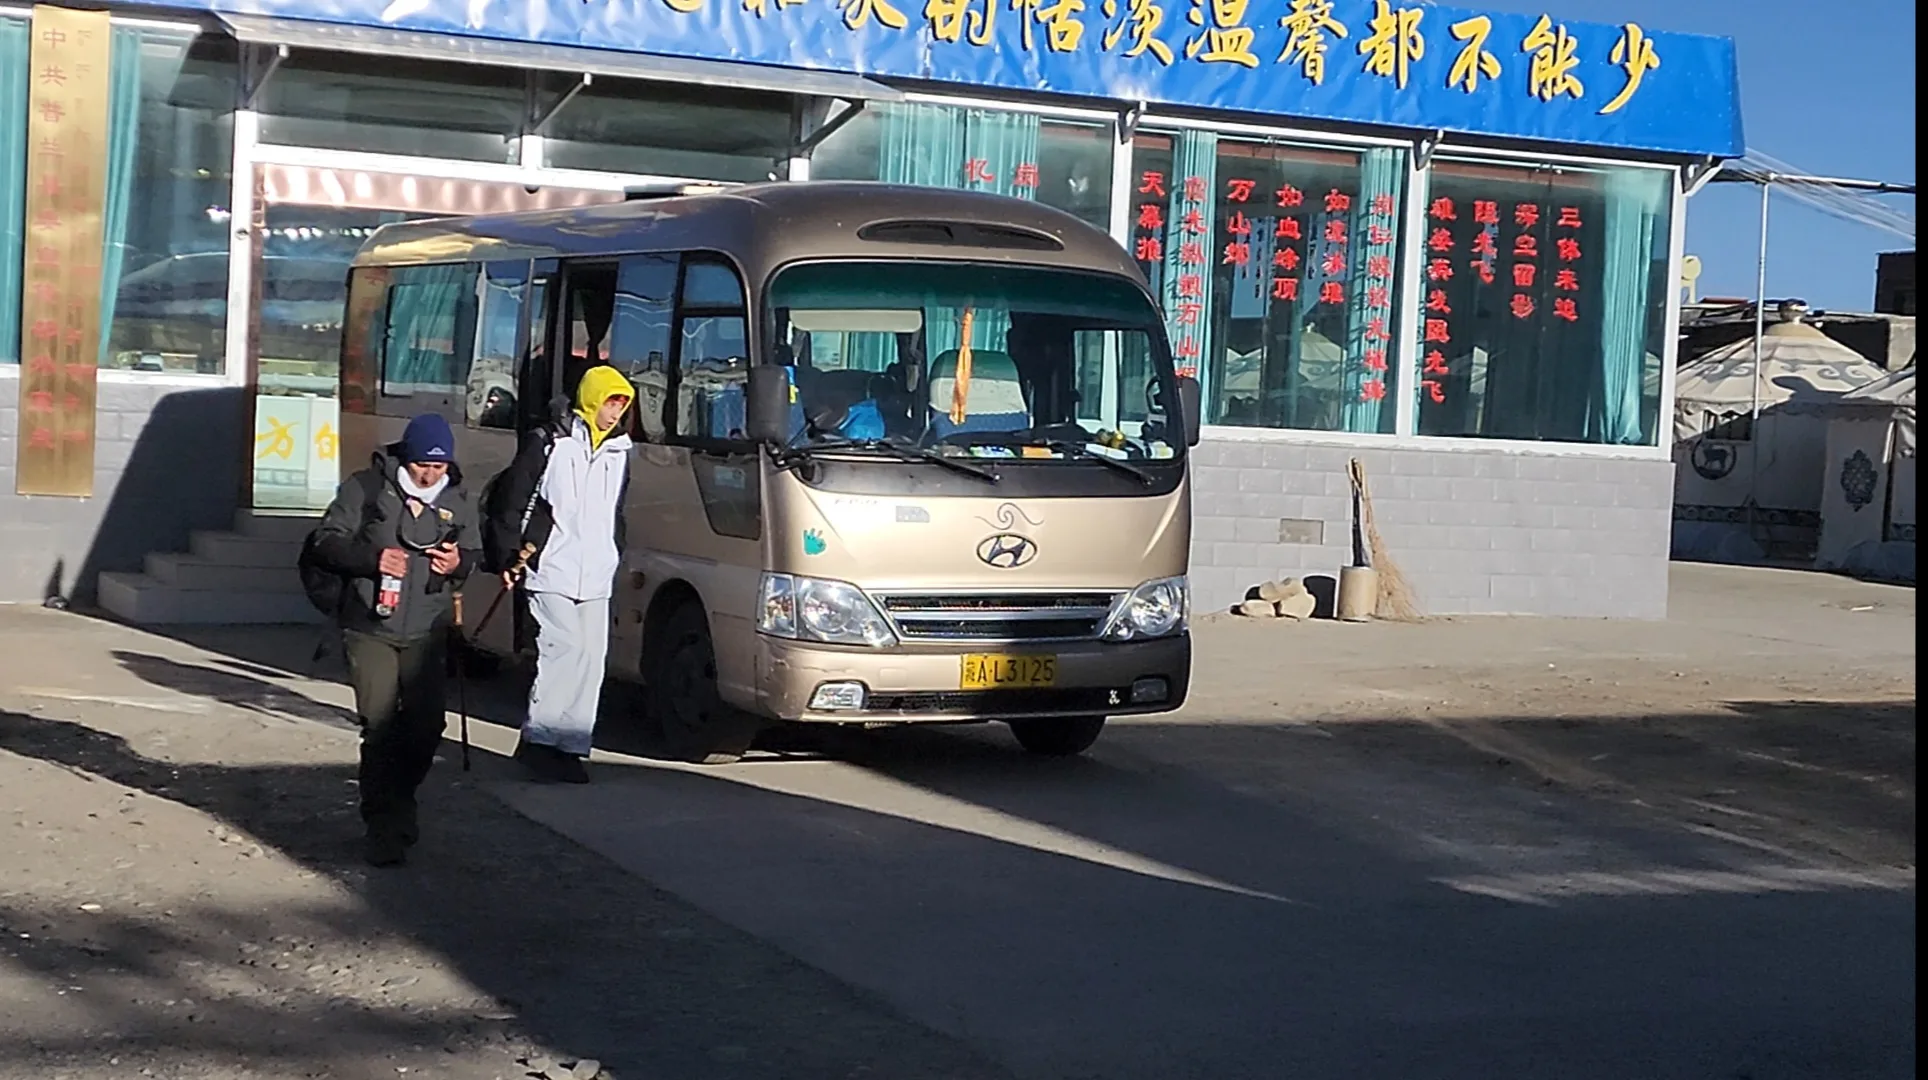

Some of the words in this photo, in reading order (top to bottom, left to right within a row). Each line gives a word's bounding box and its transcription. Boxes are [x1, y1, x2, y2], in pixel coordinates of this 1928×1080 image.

[660, 0, 1661, 116] 的恬淡温馨都不能少
